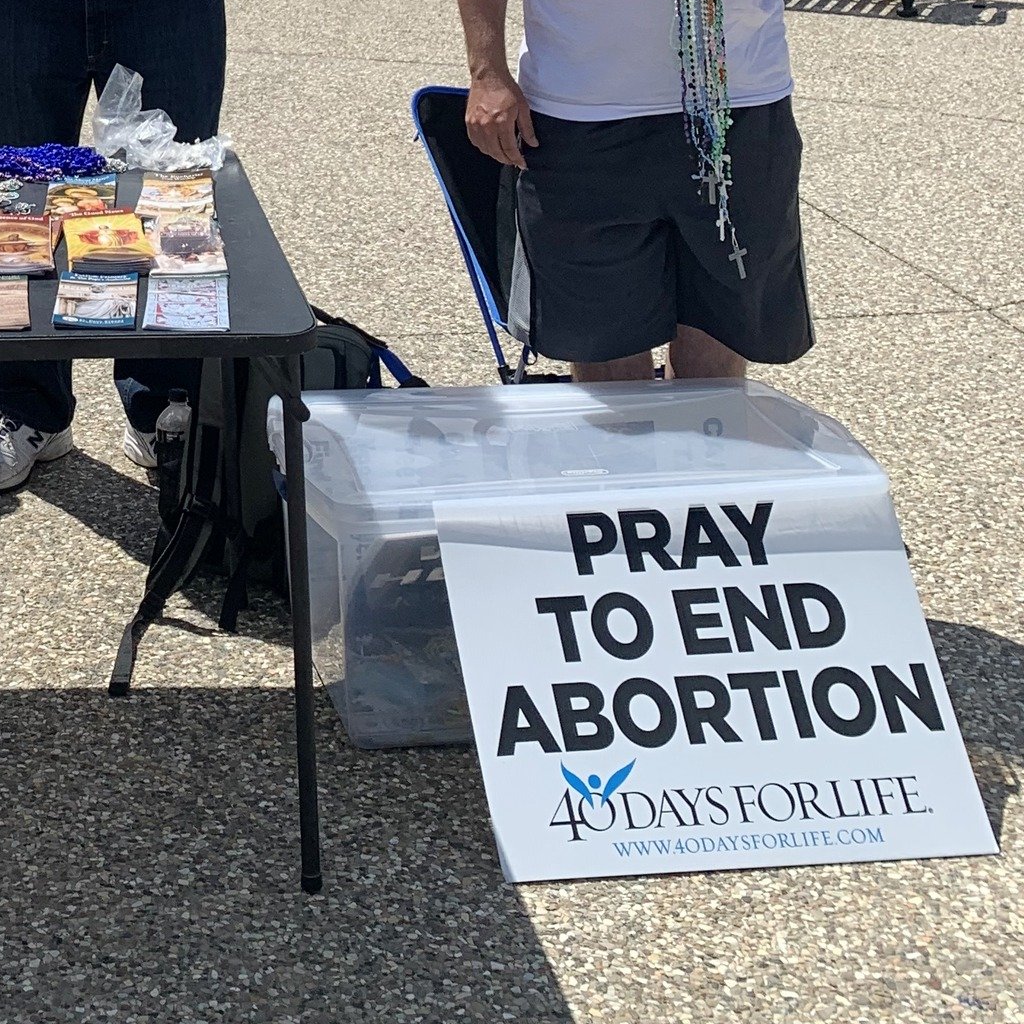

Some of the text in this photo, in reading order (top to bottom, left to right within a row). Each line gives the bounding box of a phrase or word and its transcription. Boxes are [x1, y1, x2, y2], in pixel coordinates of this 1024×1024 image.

[566, 501, 774, 576] PRAY
[535, 581, 847, 663] TO END
[496, 663, 945, 757] ABORTION
[549, 787, 616, 842] 40
[617, 785, 729, 831] DAYS
[729, 782, 835, 824] FOR
[612, 827, 886, 858] WWW.40DAYSFORLIFE.COM
